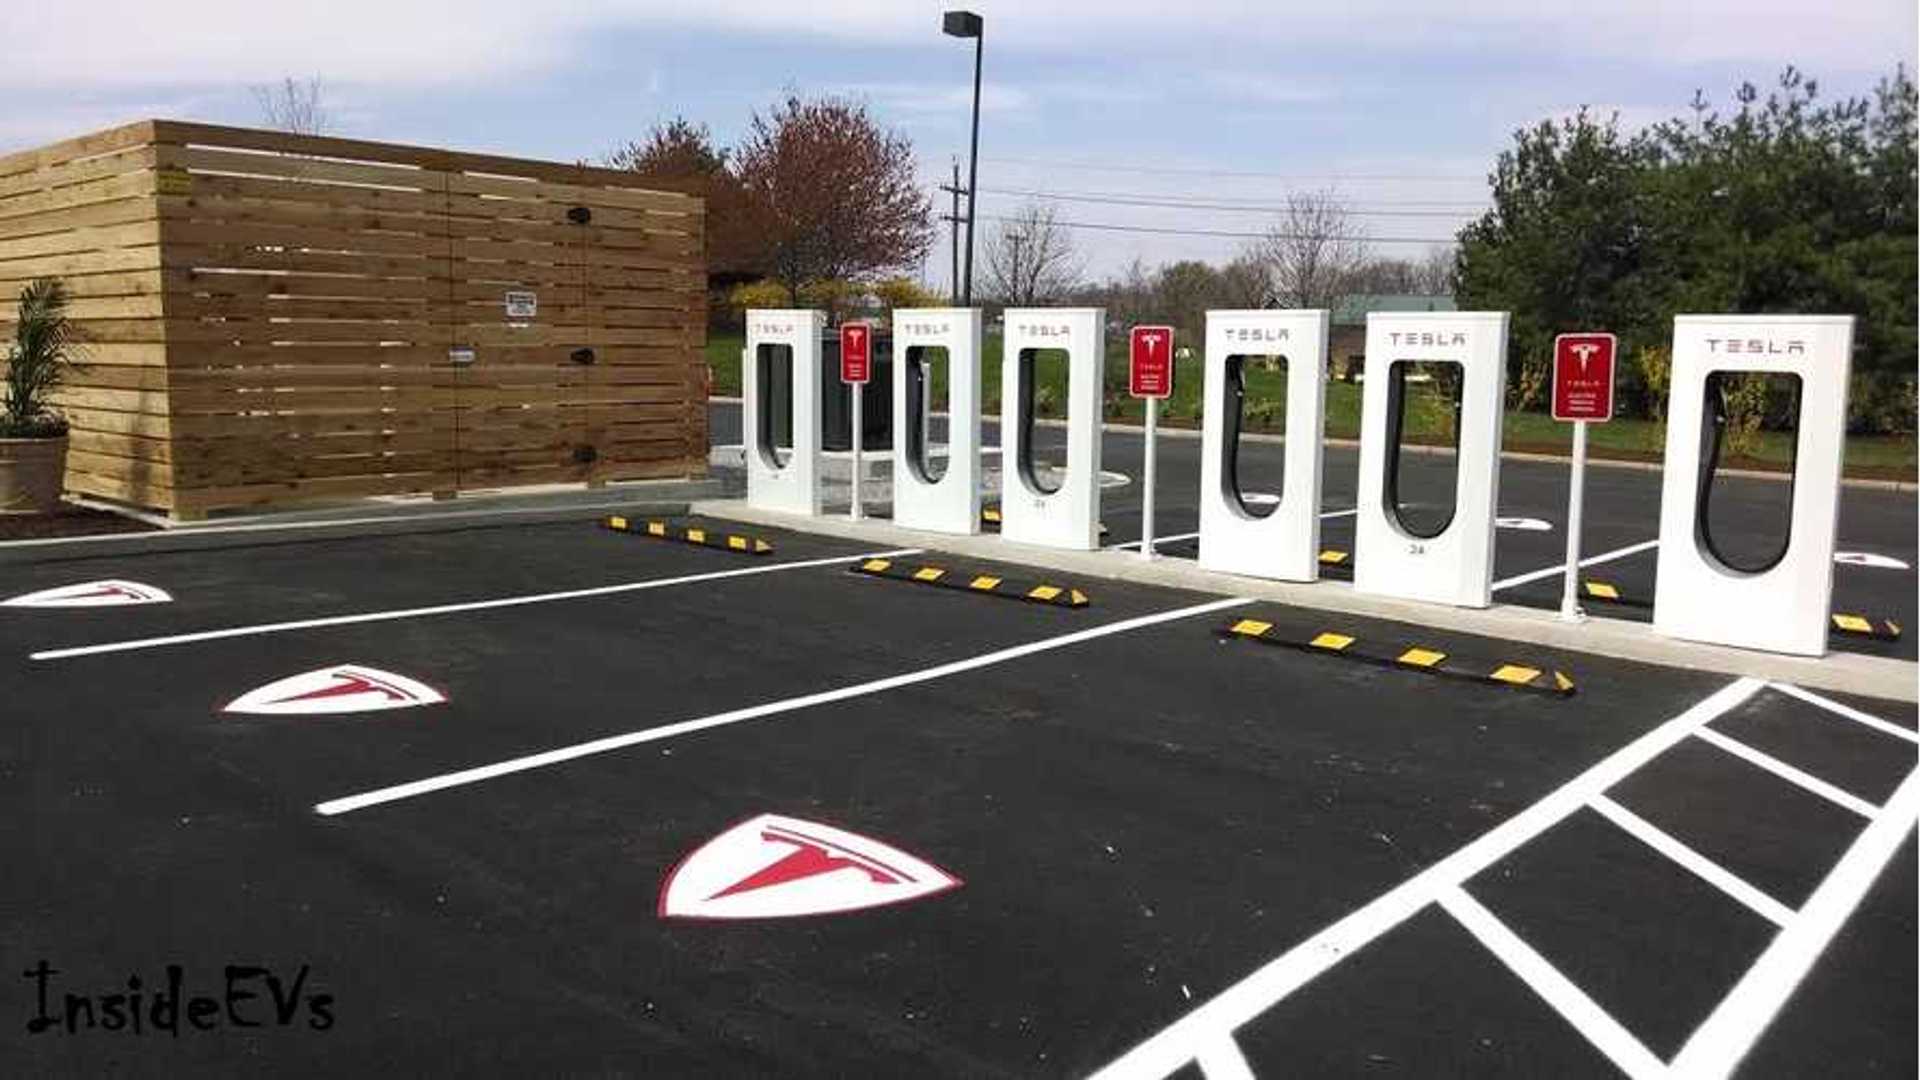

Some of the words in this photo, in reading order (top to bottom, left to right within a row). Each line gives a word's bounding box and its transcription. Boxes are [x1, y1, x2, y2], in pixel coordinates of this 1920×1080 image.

[904, 323, 950, 336] TESLA
[1018, 324, 1071, 337] TESLA
[1224, 327, 1290, 342] TESLA
[1388, 331, 1467, 347] TESLA
[1704, 337, 1806, 355] TESLA
